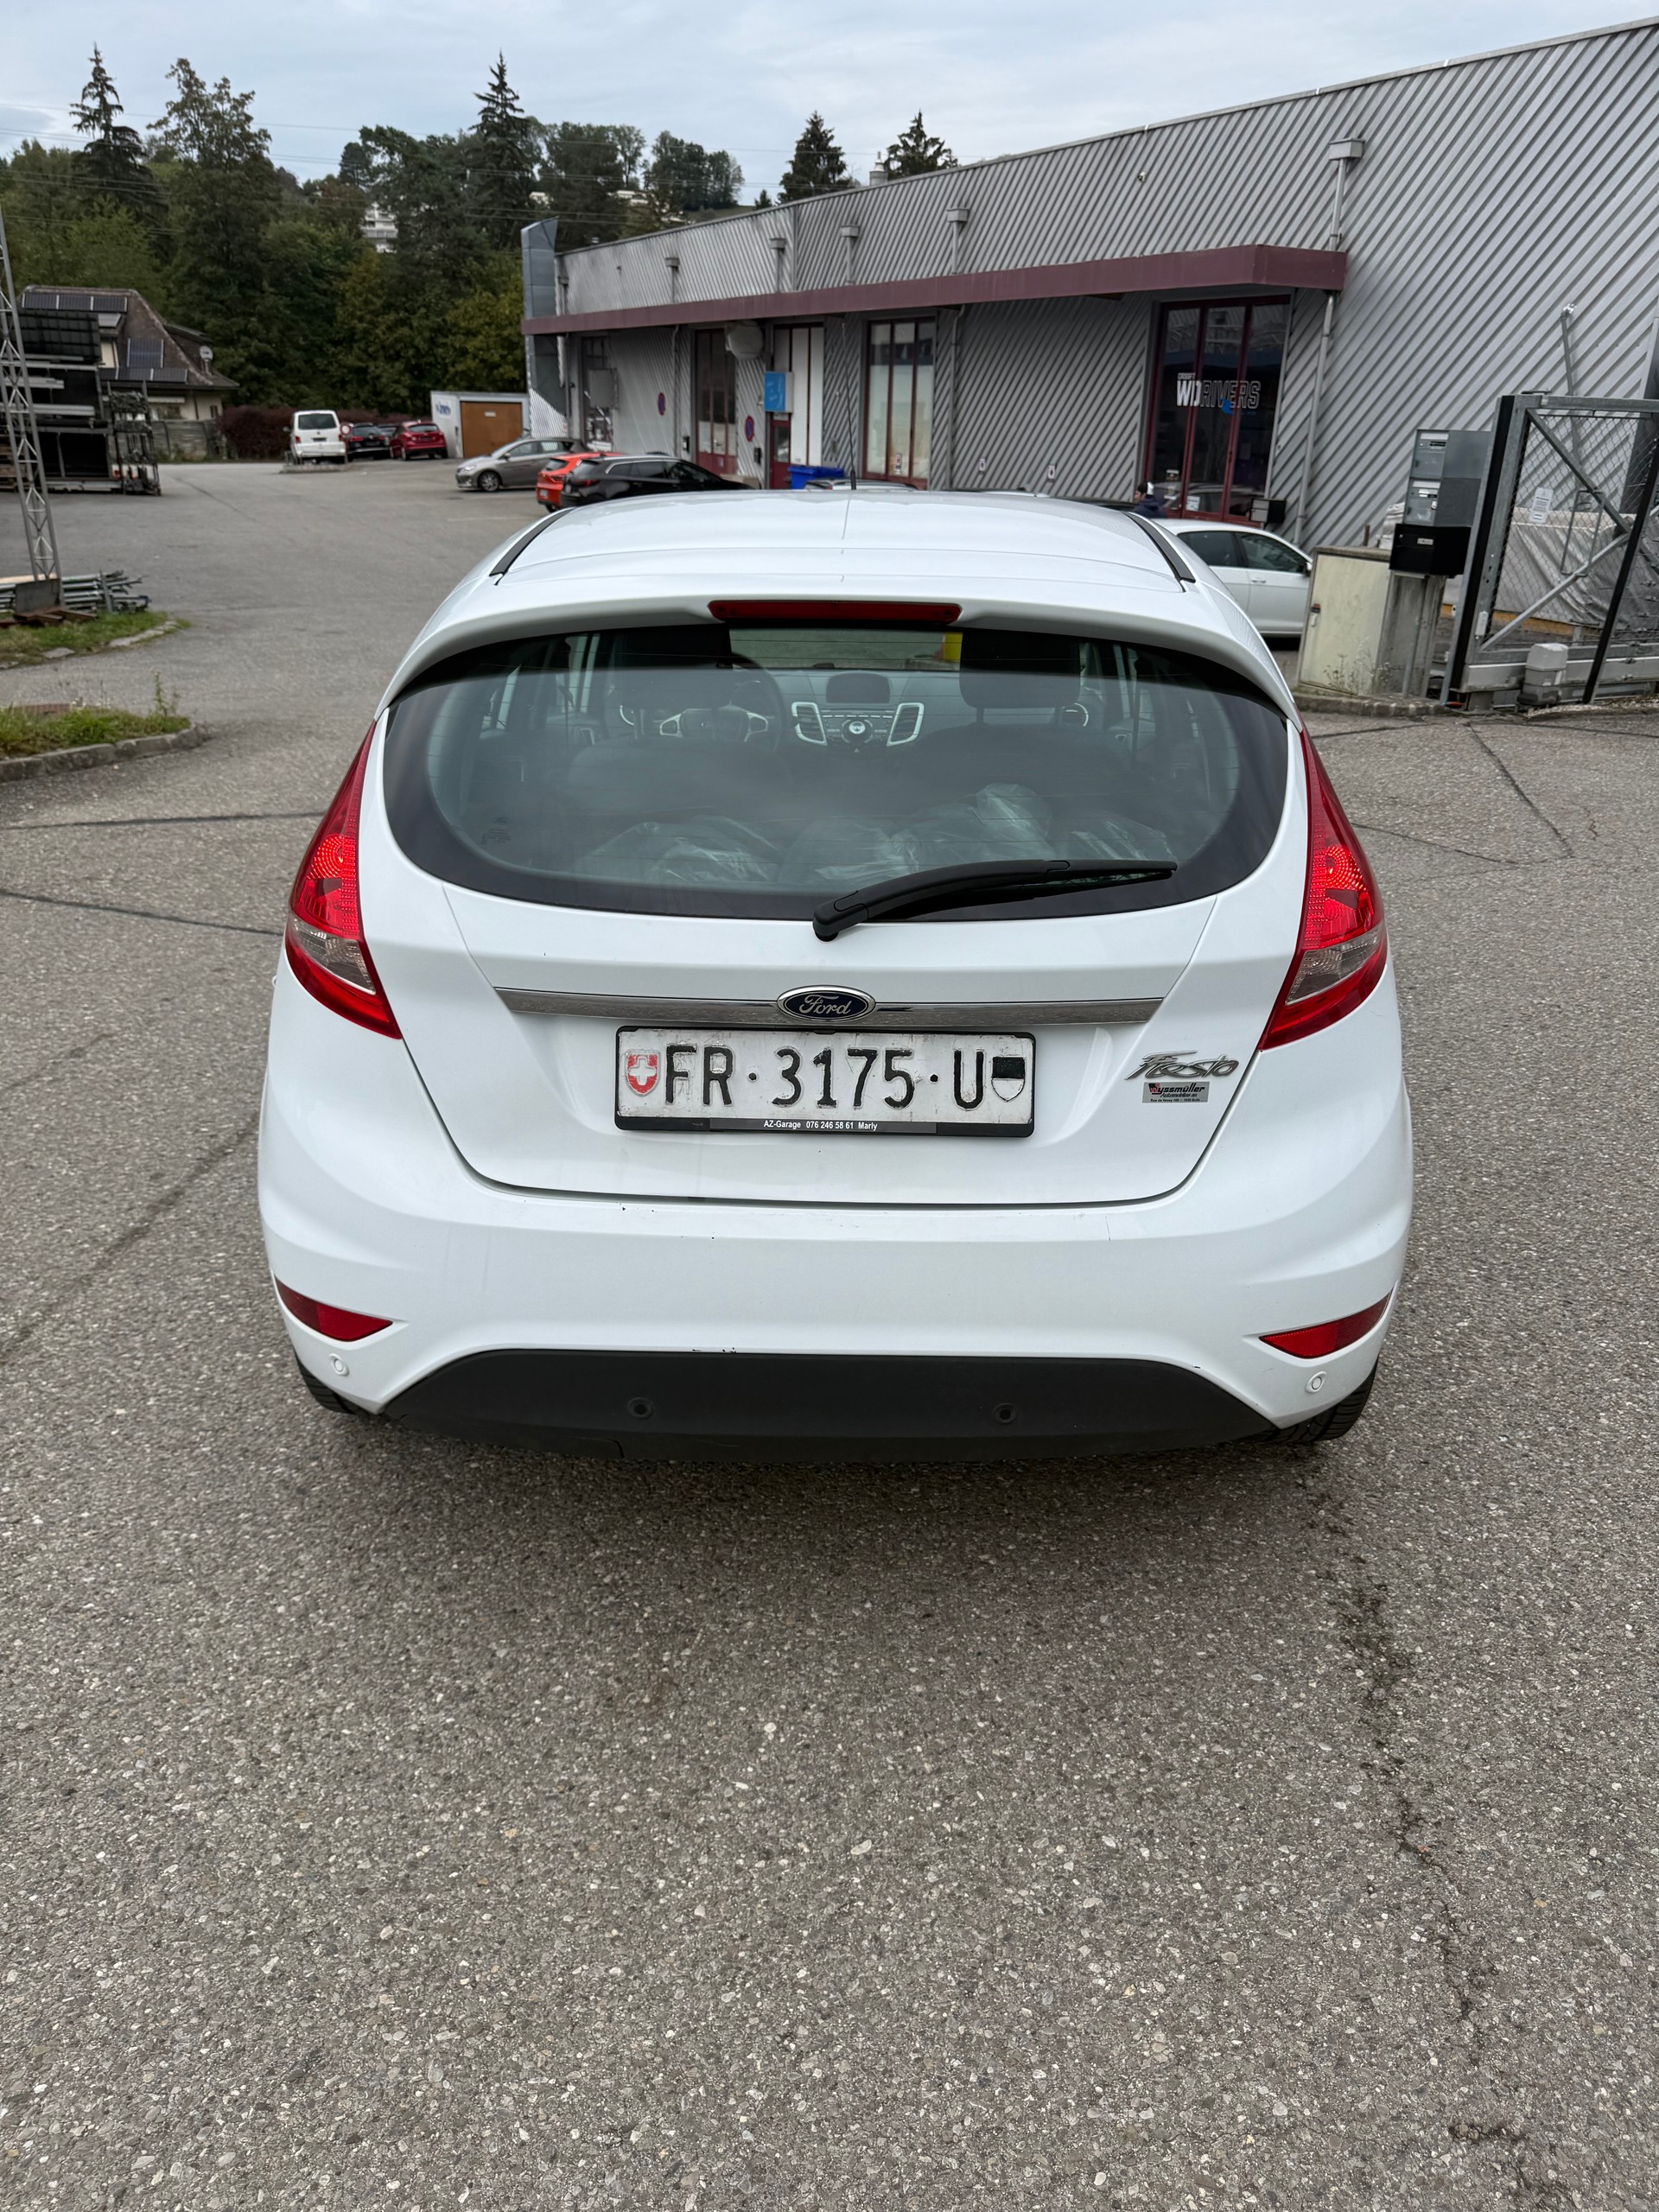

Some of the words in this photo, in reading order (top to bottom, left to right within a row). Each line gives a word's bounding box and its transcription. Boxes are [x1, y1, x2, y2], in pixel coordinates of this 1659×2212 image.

[798, 995, 853, 1014] Ford
[1124, 1050, 1239, 1079] Fiesta
[763, 1120, 802, 1130] AZ-Garage
[858, 1122, 878, 1131] Marly
